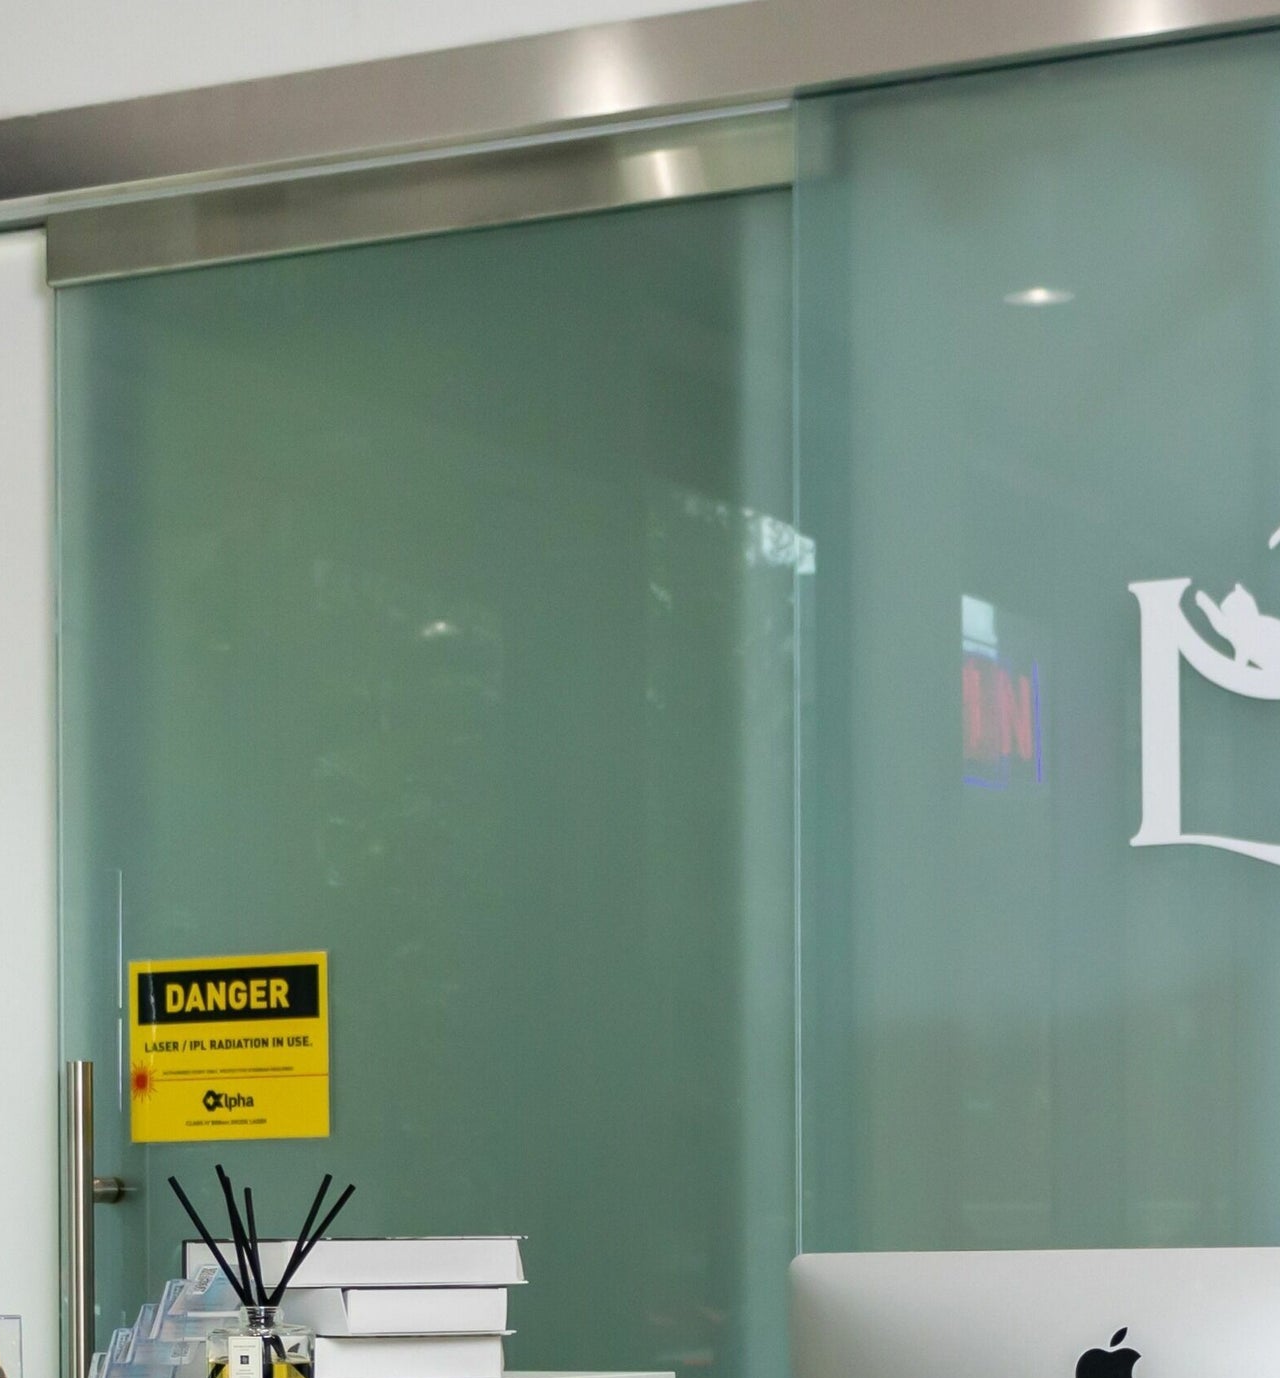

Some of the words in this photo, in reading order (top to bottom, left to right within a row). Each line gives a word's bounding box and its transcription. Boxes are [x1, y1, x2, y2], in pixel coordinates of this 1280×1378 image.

[166, 979, 290, 1014] DANGER
[144, 1037, 179, 1053] LASER
[189, 1038, 207, 1051] IPL
[209, 1036, 269, 1050] RADIATION
[272, 1036, 283, 1048] IN
